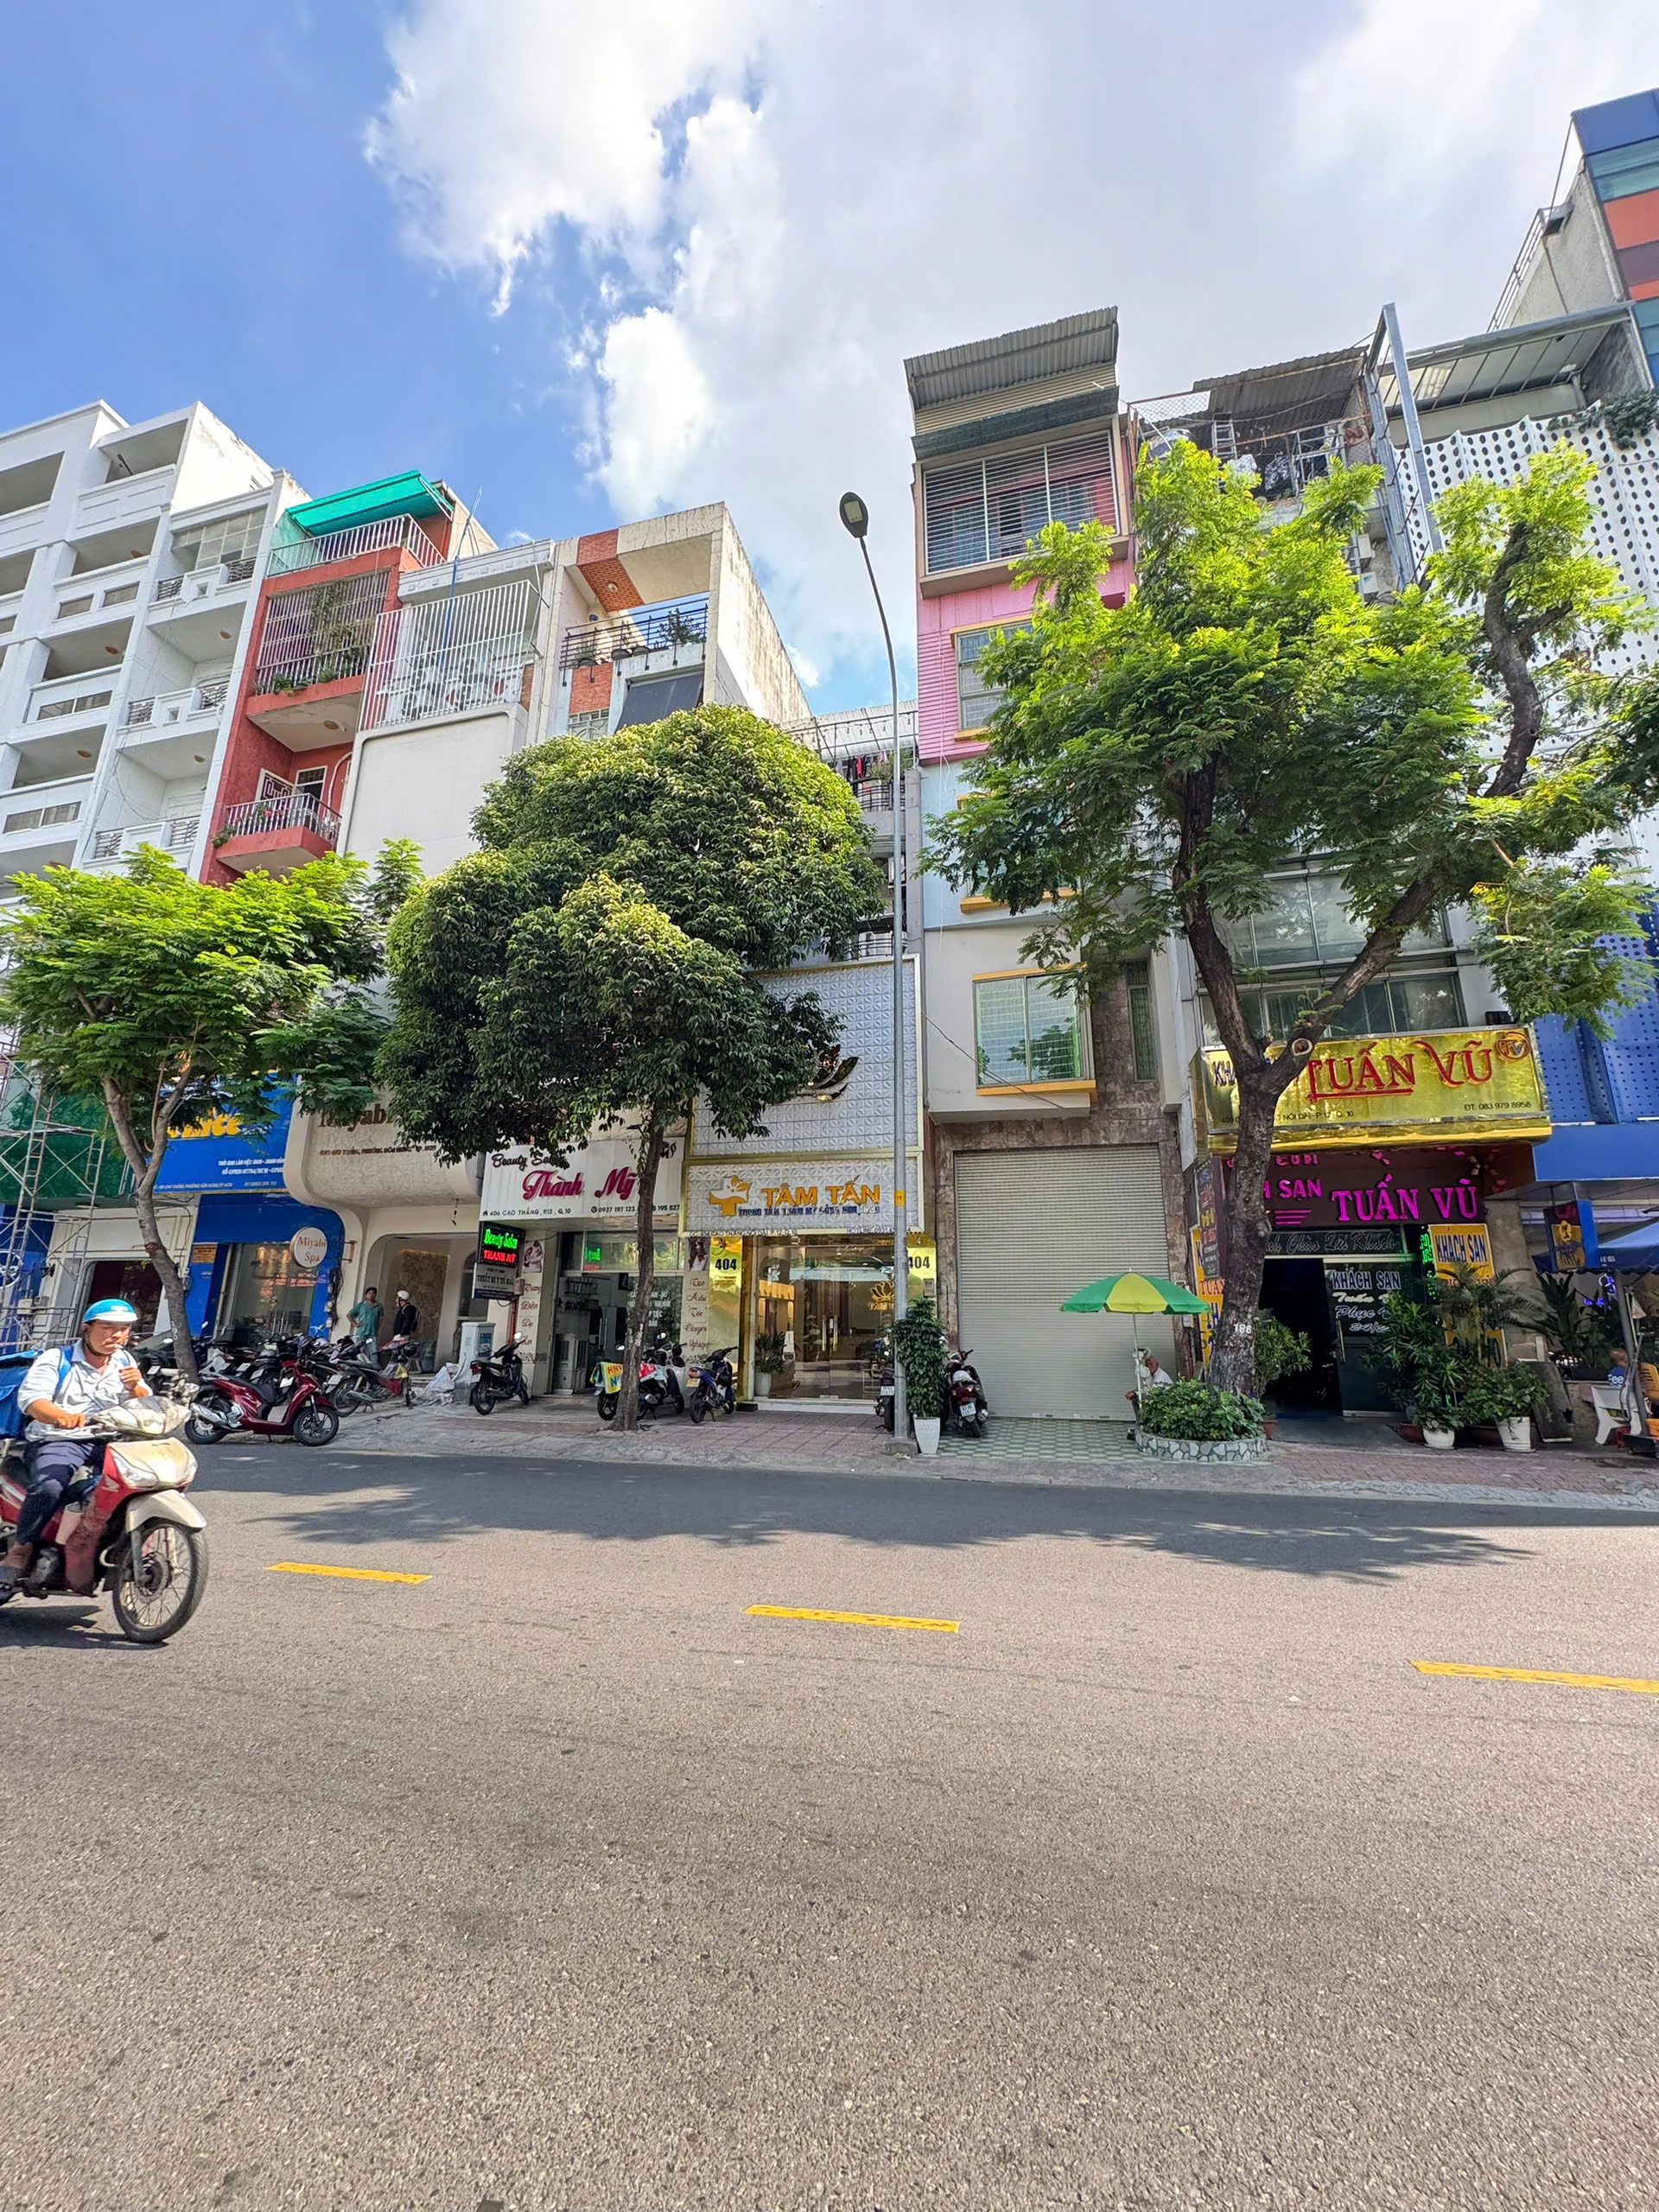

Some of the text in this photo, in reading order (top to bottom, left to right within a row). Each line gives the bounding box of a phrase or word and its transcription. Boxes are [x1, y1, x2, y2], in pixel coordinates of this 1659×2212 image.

[1306, 1039, 1493, 1101] TUẤN VŨ
[492, 1154, 528, 1171] Beauty
[522, 1166, 638, 1201] Thành Mỹ
[761, 1175, 880, 1207] TÂM TẤN
[1279, 1179, 1322, 1202] SẠN
[1331, 1173, 1478, 1221] TUẤN VŨ
[298, 1236, 327, 1249] Miyabi
[304, 1252, 320, 1264] Spa
[715, 1258, 737, 1271] 404
[1332, 1267, 1372, 1290] KHÁCH
[1335, 1305, 1376, 1320] Phục
